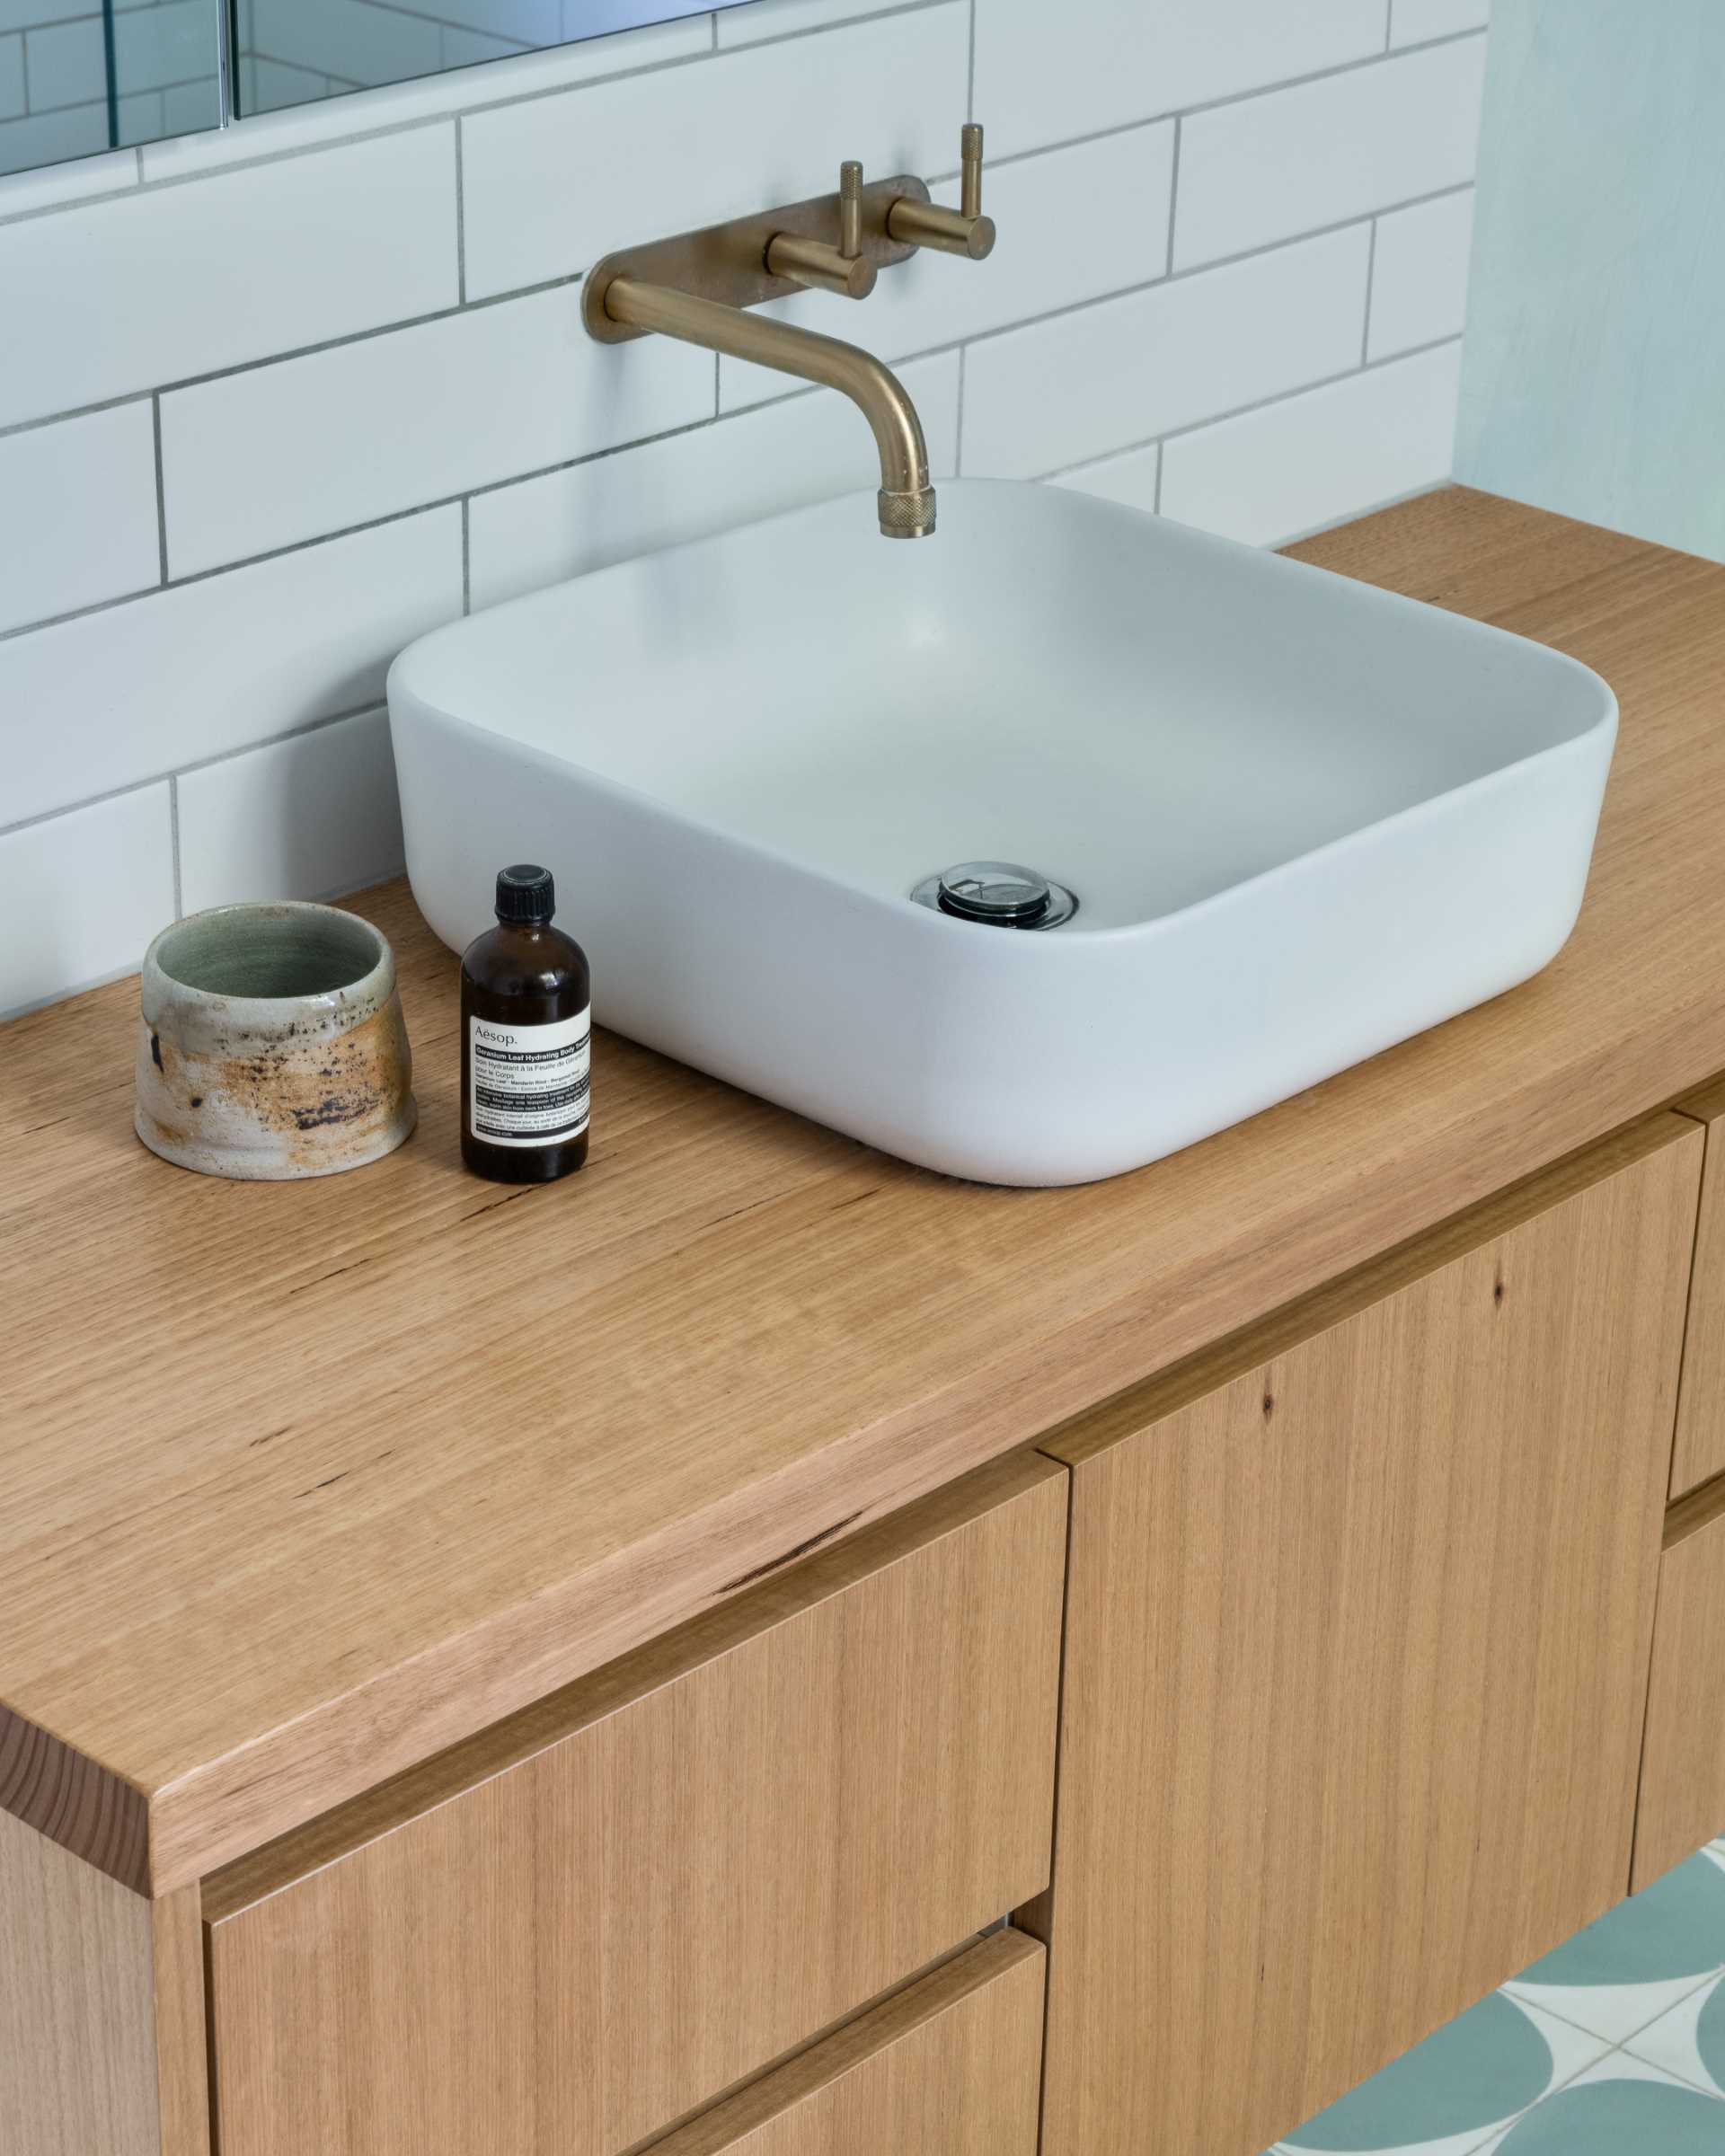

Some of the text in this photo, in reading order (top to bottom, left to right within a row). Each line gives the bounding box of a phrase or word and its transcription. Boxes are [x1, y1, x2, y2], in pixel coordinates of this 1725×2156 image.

[477, 1047, 507, 1059] Geranium
[526, 1051, 559, 1062] Hydrating
[560, 1046, 575, 1056] Body
[495, 1071, 515, 1079] Corps
